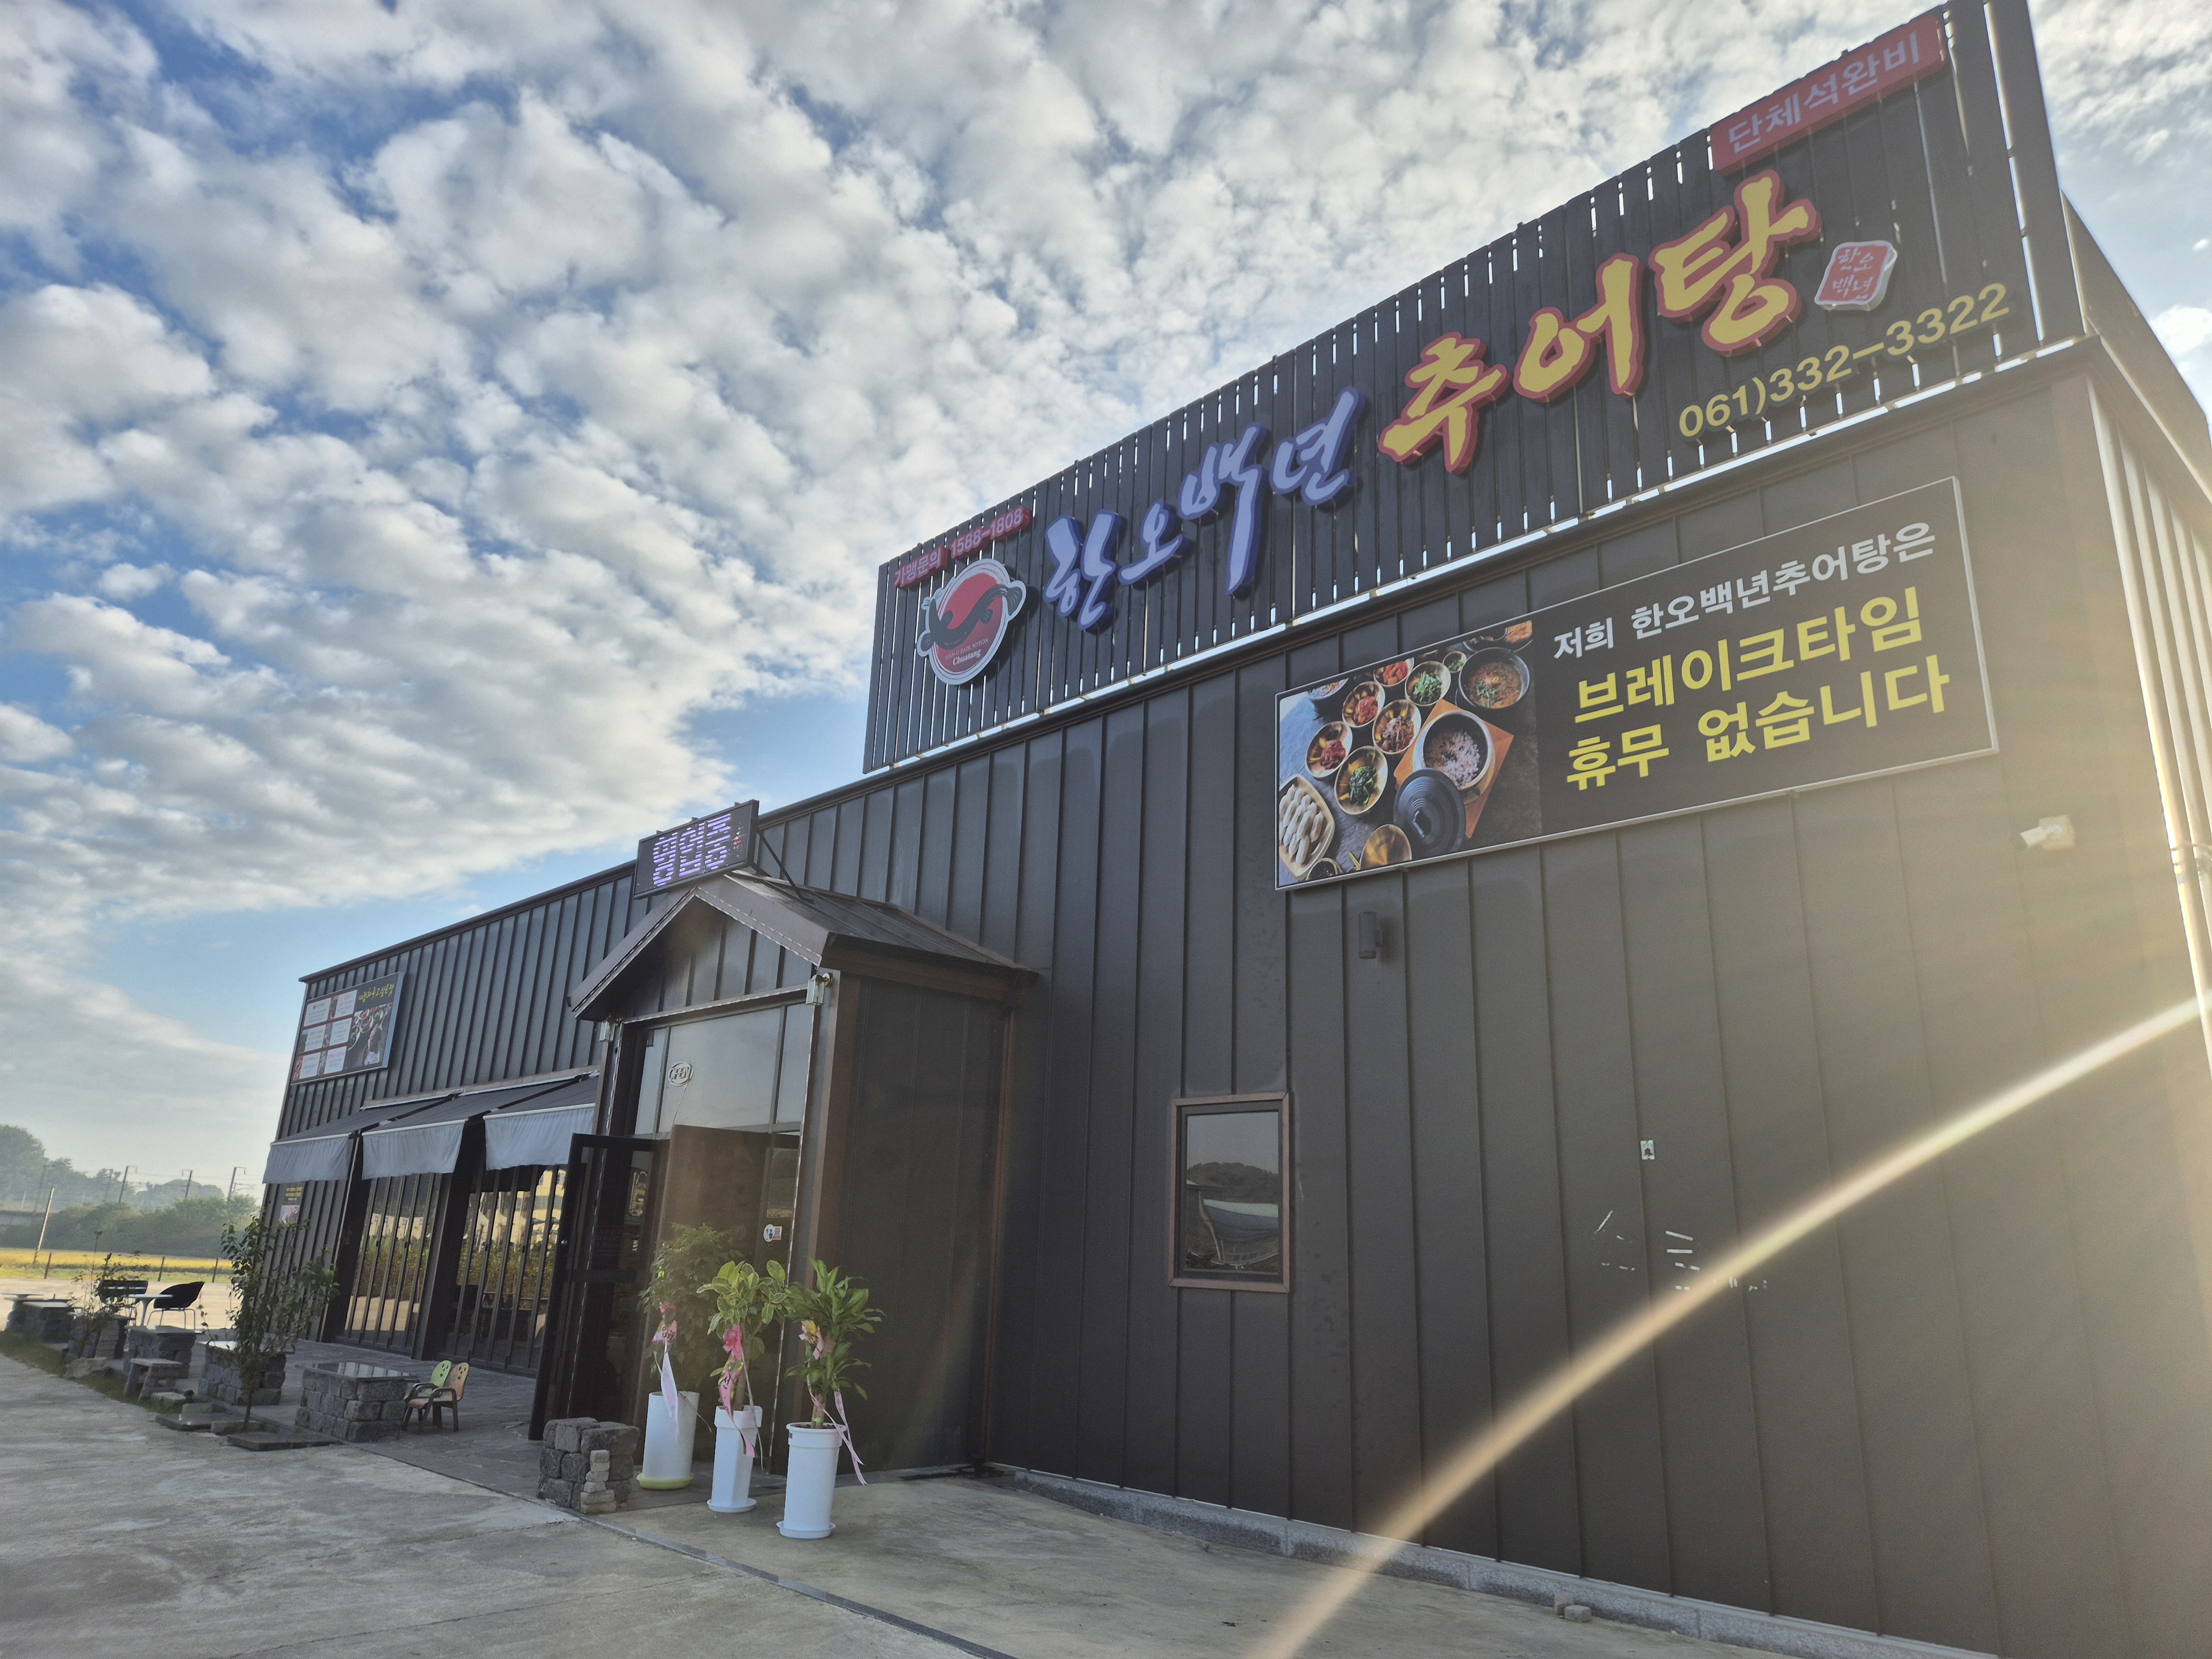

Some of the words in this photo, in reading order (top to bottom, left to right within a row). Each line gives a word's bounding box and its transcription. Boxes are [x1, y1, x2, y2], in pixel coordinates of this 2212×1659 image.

[1729, 32, 1920, 154] 단체석완비
[1043, 387, 1361, 630] 한오백년
[1378, 169, 1820, 474] 추어탕
[1679, 283, 2010, 437] 061)332-3322
[894, 547, 941, 585] 가맹문의
[951, 508, 1022, 556] 1588-1808
[1553, 617, 1615, 660] 저희
[1630, 521, 1936, 640] 한오백년추어탕은
[953, 649, 981, 665] Chuatang
[972, 637, 989, 649] NYEON
[1574, 586, 1923, 723] 브레이크타임
[1566, 723, 1670, 791] 휴무
[1697, 655, 1950, 762] 없습니다
[652, 813, 731, 886] 영업중
